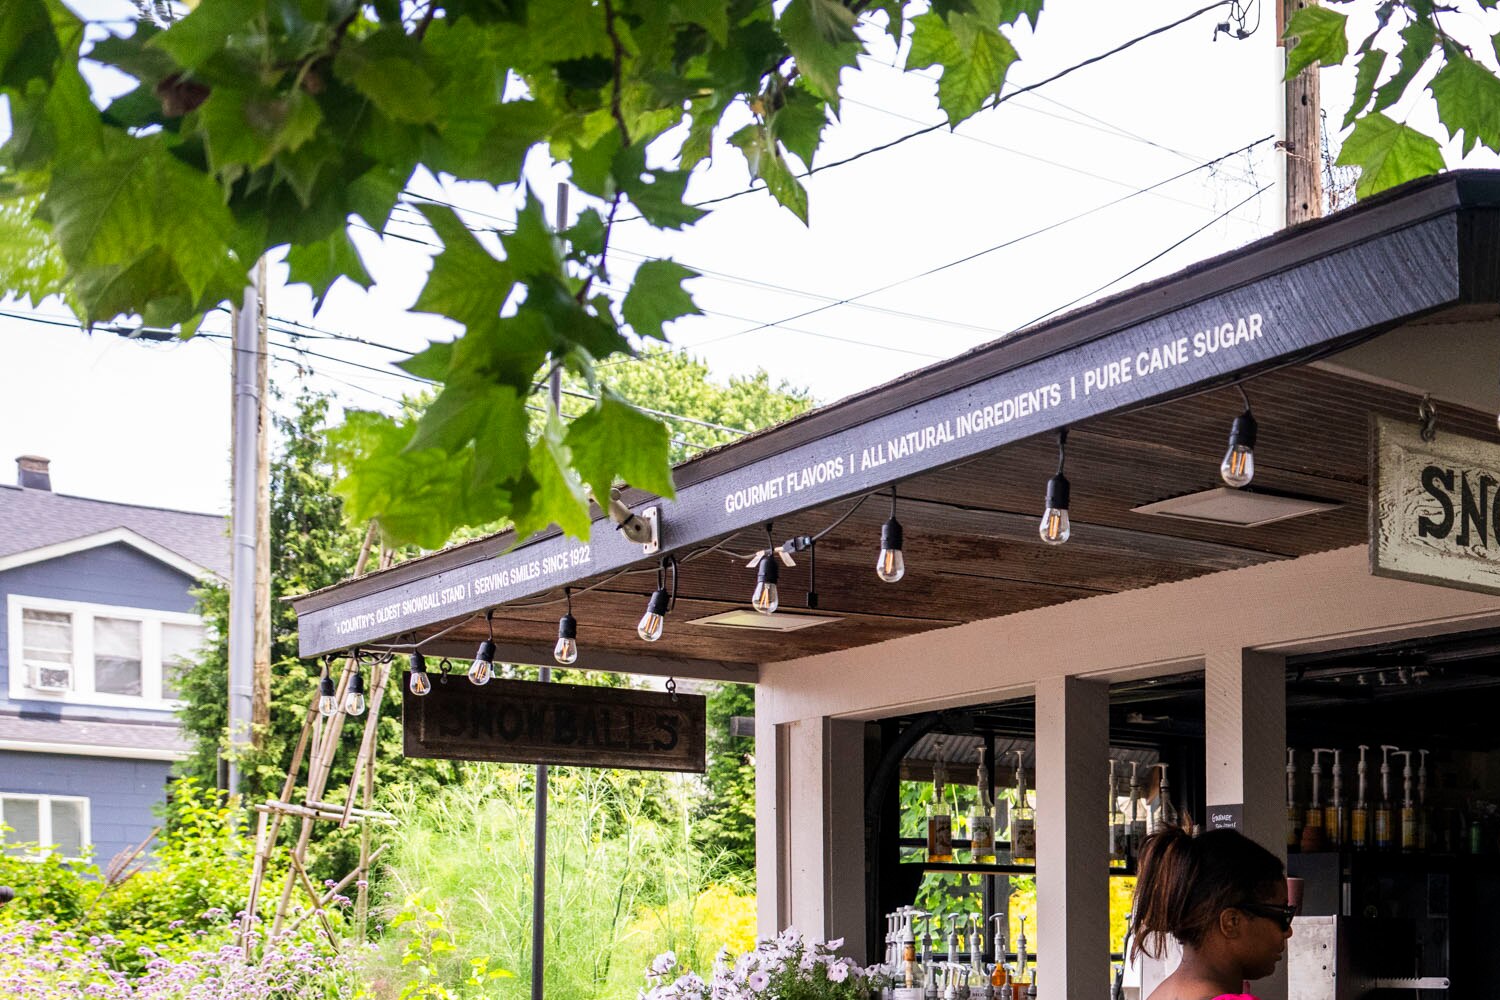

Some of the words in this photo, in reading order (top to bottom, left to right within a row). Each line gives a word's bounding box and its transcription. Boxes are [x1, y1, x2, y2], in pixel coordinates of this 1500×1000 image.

[724, 476, 784, 514] GOURMET
[786, 457, 844, 493] FLAVORS
[861, 444, 886, 471] ALL
[887, 420, 954, 461] NATURAL
[956, 383, 1061, 438] INGREDIENTS
[1084, 357, 1132, 395] PURE
[1135, 337, 1189, 376] CANE
[1193, 313, 1263, 358] SUGAR
[341, 612, 375, 634] COUNTRY'S
[375, 602, 401, 624] OLDEST
[402, 592, 441, 616] SNOWBALL
[441, 584, 465, 605] STAND
[474, 571, 509, 595] SERVING
[510, 560, 540, 584] SMILES
[542, 552, 569, 575] SINCE
[569, 545, 591, 567] 1922
